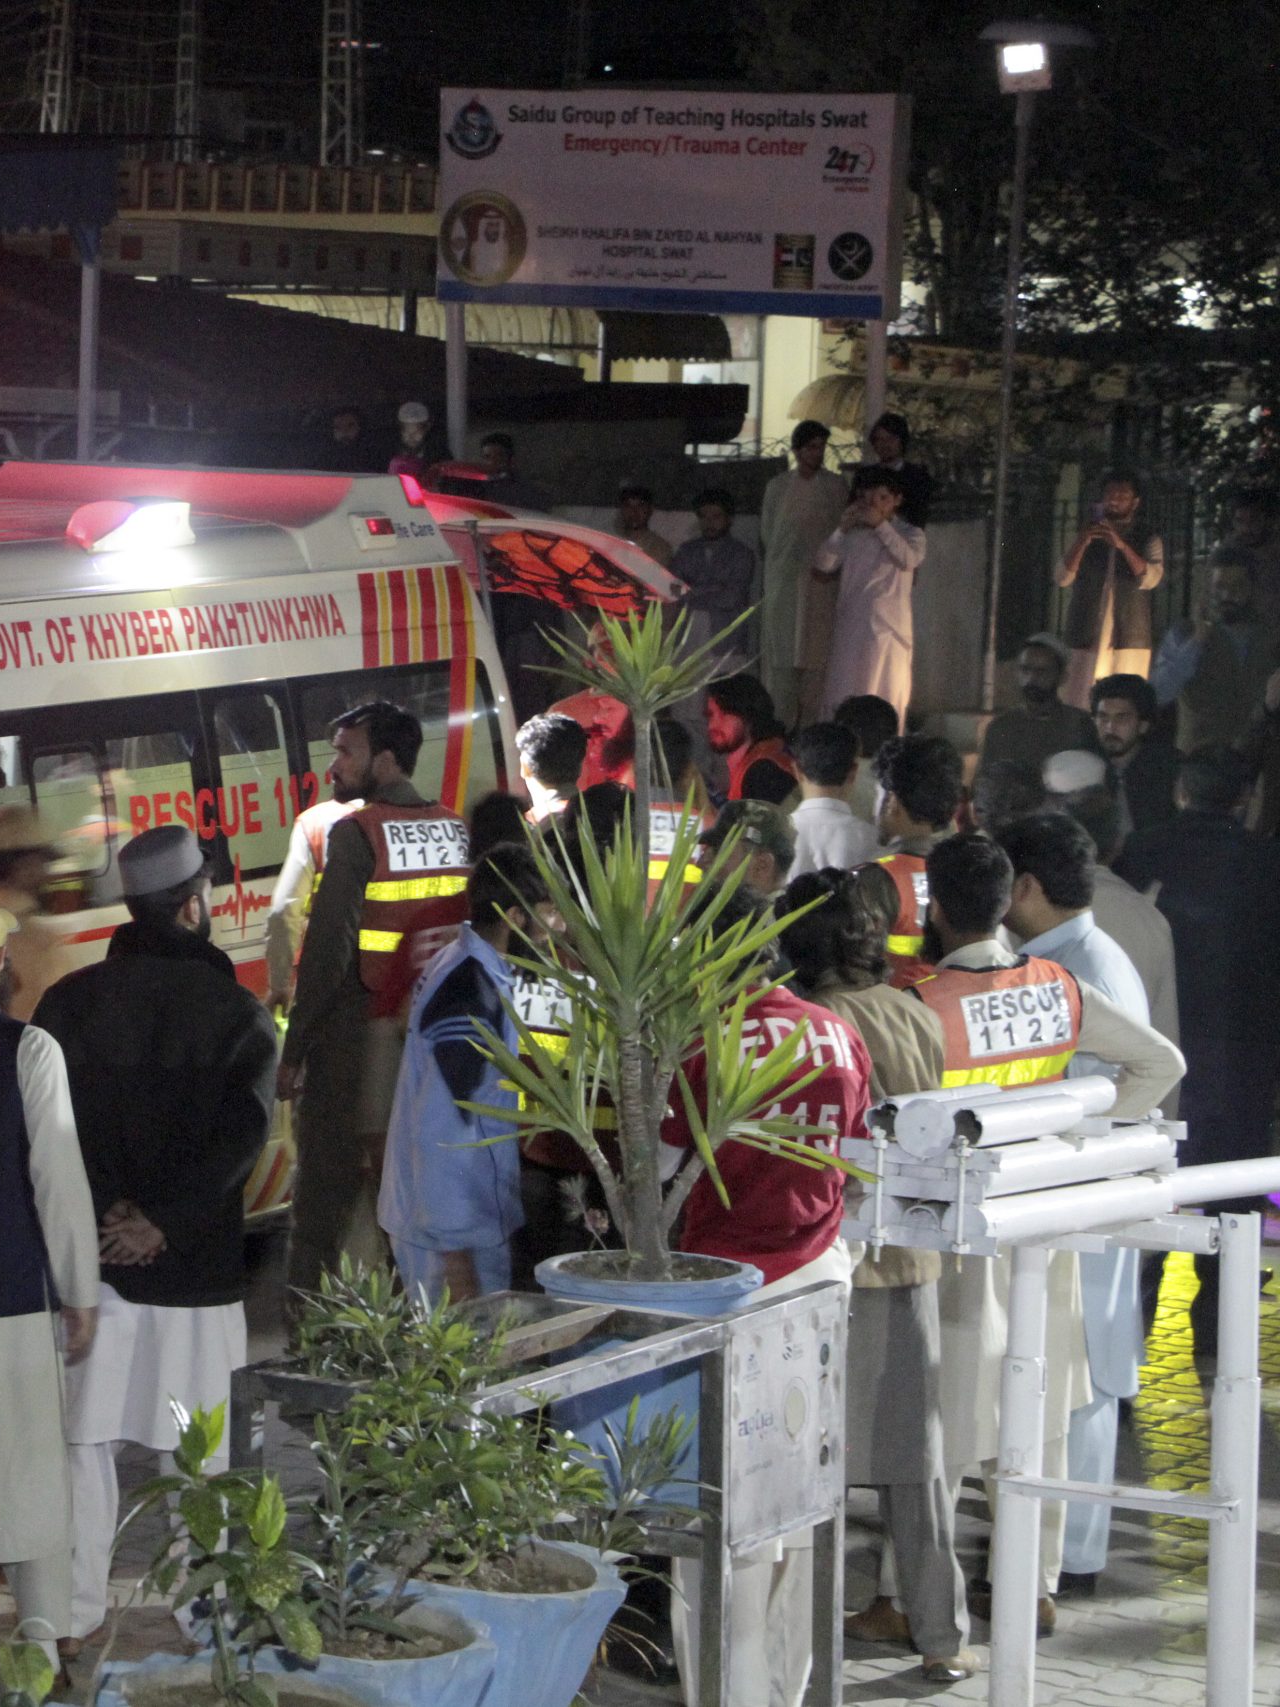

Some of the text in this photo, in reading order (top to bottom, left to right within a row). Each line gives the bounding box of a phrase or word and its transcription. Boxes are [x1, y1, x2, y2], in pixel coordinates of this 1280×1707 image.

[507, 104, 868, 131] Saidu Group of Teaching Hospitals Swat
[564, 134, 808, 156] Emergency/Trauma Center
[655, 229, 694, 242] ZAYED
[603, 245, 694, 260] HOSPITAL SWAT
[45, 616, 77, 664] OF
[79, 607, 179, 661] KHYBER
[178, 593, 347, 651] PAKHTUNKHWA
[129, 769, 333, 840] RESCUE 112
[387, 822, 470, 845] RESCUE
[397, 845, 469, 867] 1122
[722, 1017, 854, 1071] EDHI
[980, 1014, 1067, 1050] 1122
